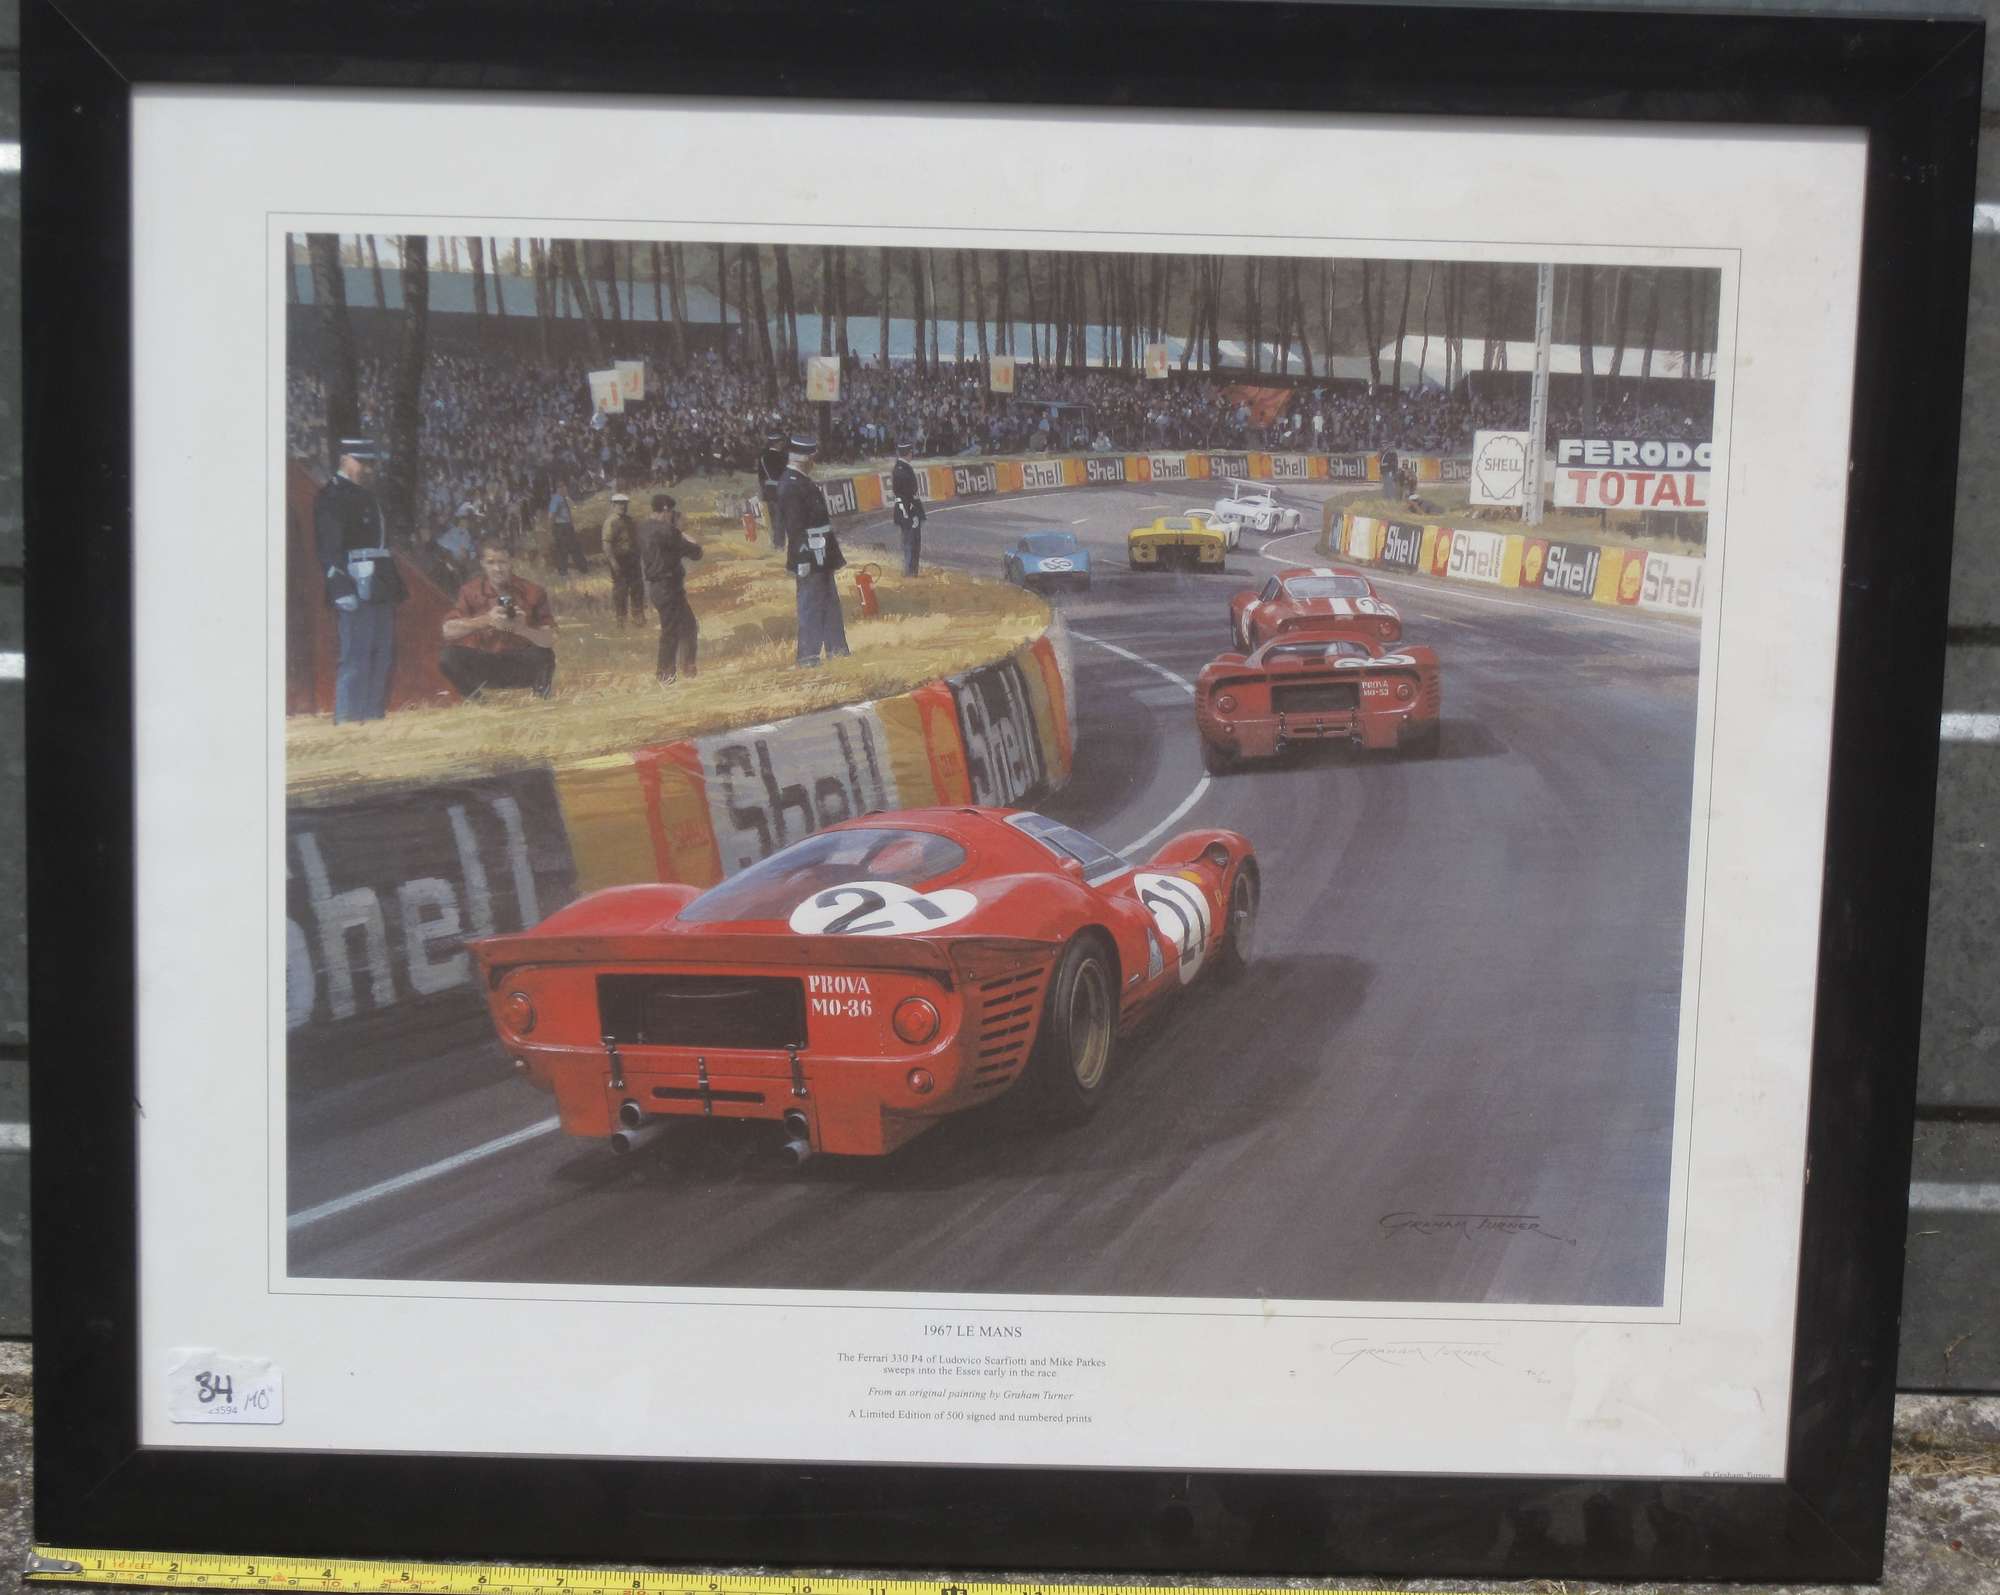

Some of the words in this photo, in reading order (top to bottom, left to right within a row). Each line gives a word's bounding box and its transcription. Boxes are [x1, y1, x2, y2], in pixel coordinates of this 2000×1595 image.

[1023, 461, 1064, 487] Shell
[1087, 457, 1125, 481] Shell
[1152, 456, 1186, 478] Shell
[1211, 457, 1248, 479] Shell
[1273, 456, 1308, 478] Shell
[1329, 457, 1367, 477] Shell
[1484, 457, 1522, 473] SHELL
[955, 464, 998, 496] Shell
[1568, 471, 1705, 506] TOTAL
[819, 481, 856, 516] hell
[1384, 525, 1421, 565] Shell
[1450, 534, 1503, 578] Shell
[1543, 546, 1599, 594] Shell
[958, 664, 1046, 806] Shell
[815, 887, 948, 935] 21
[807, 974, 872, 995] PROVA
[810, 997, 873, 1018] MO-36
[924, 1324, 952, 1337] 1967
[957, 1325, 975, 1337] LE
[979, 1326, 1022, 1338] MANS
[838, 1352, 855, 1363] The
[858, 1352, 888, 1363] Ferrari
[891, 1354, 909, 1363] 330
[911, 1354, 923, 1363] P4
[926, 1354, 937, 1364] of
[939, 1355, 982, 1365] Ludovico
[1030, 1357, 1047, 1366] and
[1050, 1357, 1074, 1367] Mike
[1077, 1358, 1107, 1368] Parkes
[883, 1366, 915, 1376] sweeps
[918, 1366, 936, 1375] into
[939, 1366, 953, 1375] the
[984, 1368, 1006, 1378] early
[1009, 1368, 1018, 1377] in
[1020, 1368, 1035, 1377] the
[1038, 1370, 1057, 1378] race
[868, 1387, 892, 1397] From
[895, 1389, 906, 1397] an
[909, 1388, 946, 1400] original
[947, 1389, 987, 1400] painting
[990, 1389, 1000, 1401] by
[1003, 1390, 1041, 1400] Graham
[1043, 1391, 1074, 1401] Turner
[848, 1409, 857, 1418] A
[859, 1409, 895, 1419] Limited
[898, 1410, 931, 1420] Edition
[934, 1410, 944, 1420] of
[946, 1411, 964, 1421] 500
[966, 1412, 996, 1423] signed
[999, 1412, 1015, 1421] and
[1018, 1413, 1064, 1423] numbered
[1066, 1414, 1093, 1424] prints
[97, 1559, 102, 1569] 1
[170, 1562, 179, 1572] 2
[247, 1566, 255, 1575] 3
[322, 1569, 332, 1578] 4
[401, 1572, 410, 1581] 5
[478, 1575, 487, 1584] 6
[556, 1577, 564, 1586] 7
[632, 1580, 641, 1589] 8
[709, 1583, 718, 1591] 9
[792, 1585, 812, 1594] 10
